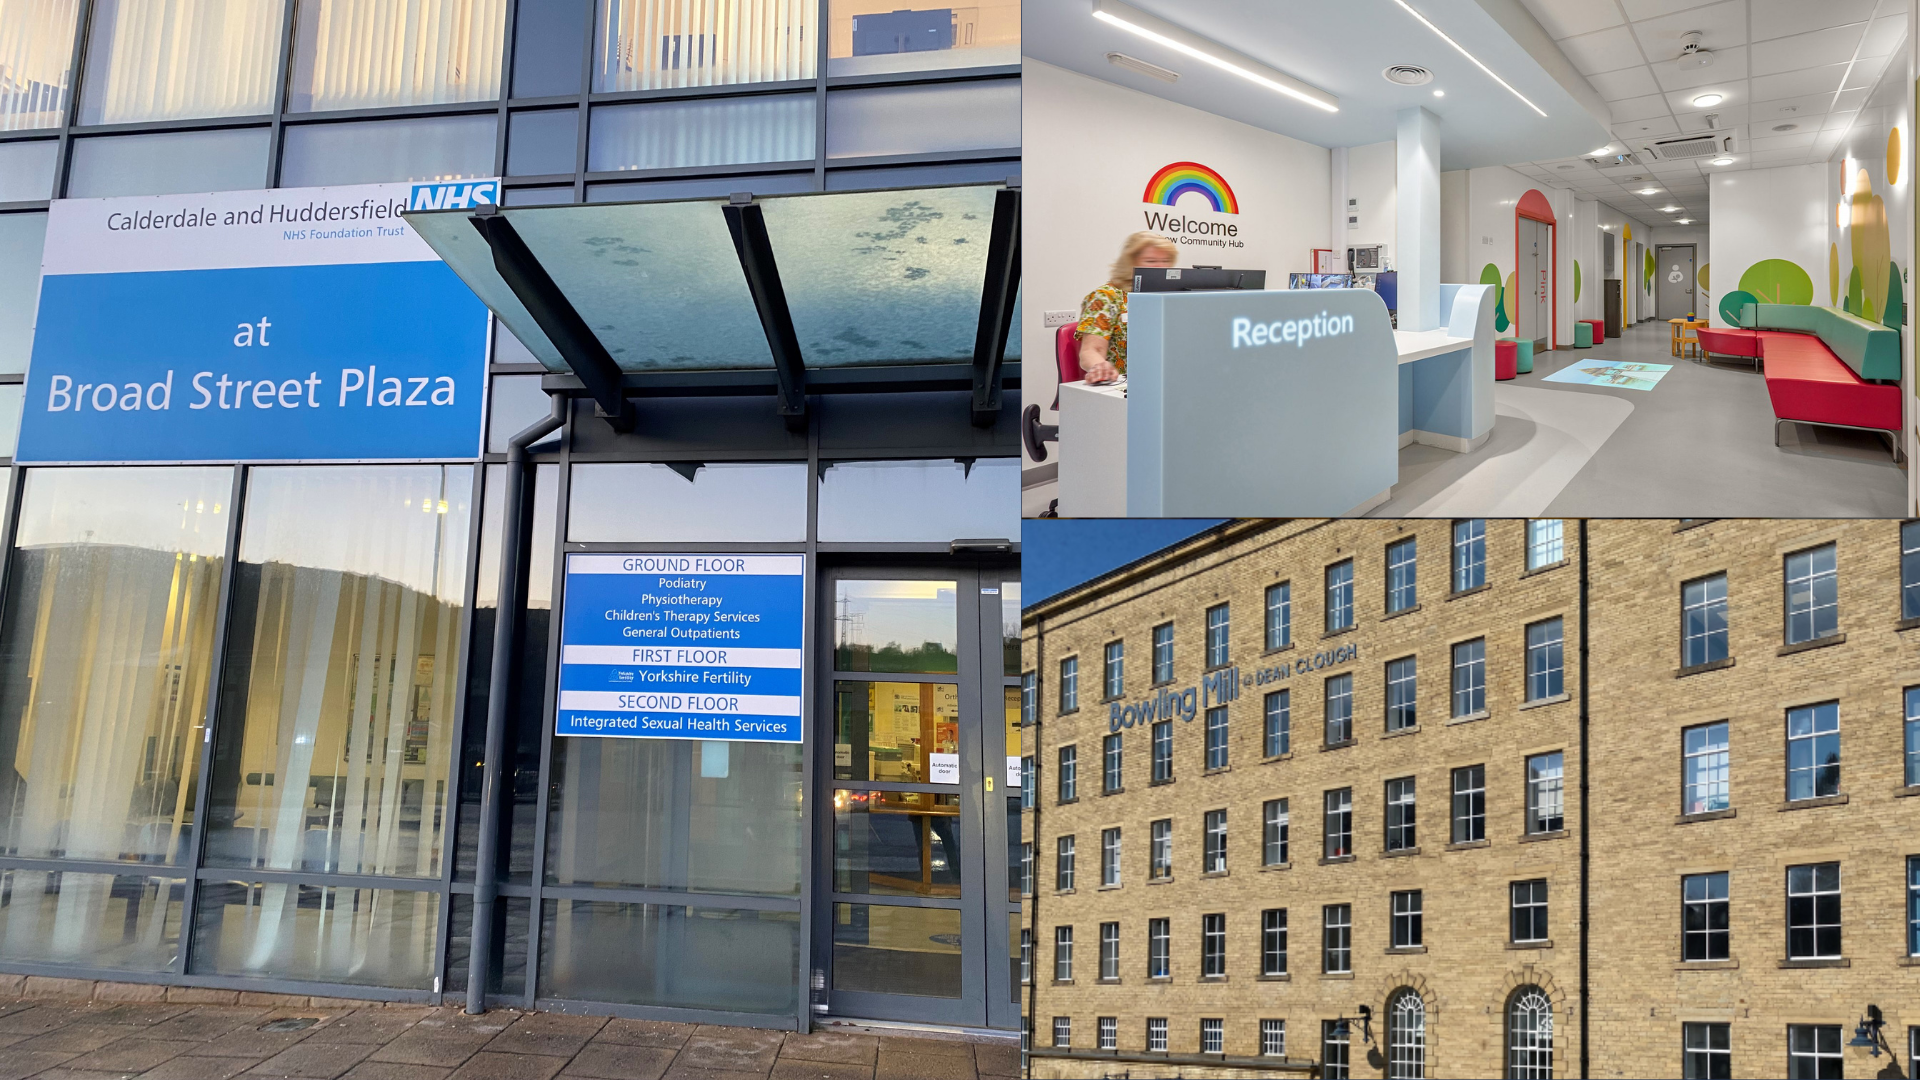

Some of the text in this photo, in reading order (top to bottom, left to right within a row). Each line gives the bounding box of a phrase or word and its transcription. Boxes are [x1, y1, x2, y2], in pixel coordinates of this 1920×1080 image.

[413, 184, 494, 210] NHS
[107, 198, 407, 231] Calderdale and Huddersfield
[1144, 210, 1238, 237] Welcome
[283, 226, 404, 240] NHS Foundation Trust
[1180, 236, 1227, 248] Community
[1228, 239, 1245, 248] Hub
[233, 316, 271, 347] at
[1232, 310, 1354, 349] Reception
[47, 365, 455, 412] Broad Street Plaza
[622, 558, 745, 572] GROUND FLOOR
[658, 577, 707, 591] Podiatry
[641, 594, 723, 608] Physiotherapy
[604, 610, 760, 625] Children's Therapy Services
[622, 626, 741, 641] General Outpatients
[633, 649, 727, 664] FIRST FLOOR
[639, 669, 752, 686] Yorkshire Fertility
[1109, 686, 1197, 732] Bowling
[1202, 667, 1239, 708] Mill
[1255, 663, 1290, 687] DEAN
[1295, 643, 1358, 675] CLOUGH
[618, 695, 739, 711] SECOND FLOOR
[571, 715, 787, 733] Integrated Sexual Health Services
